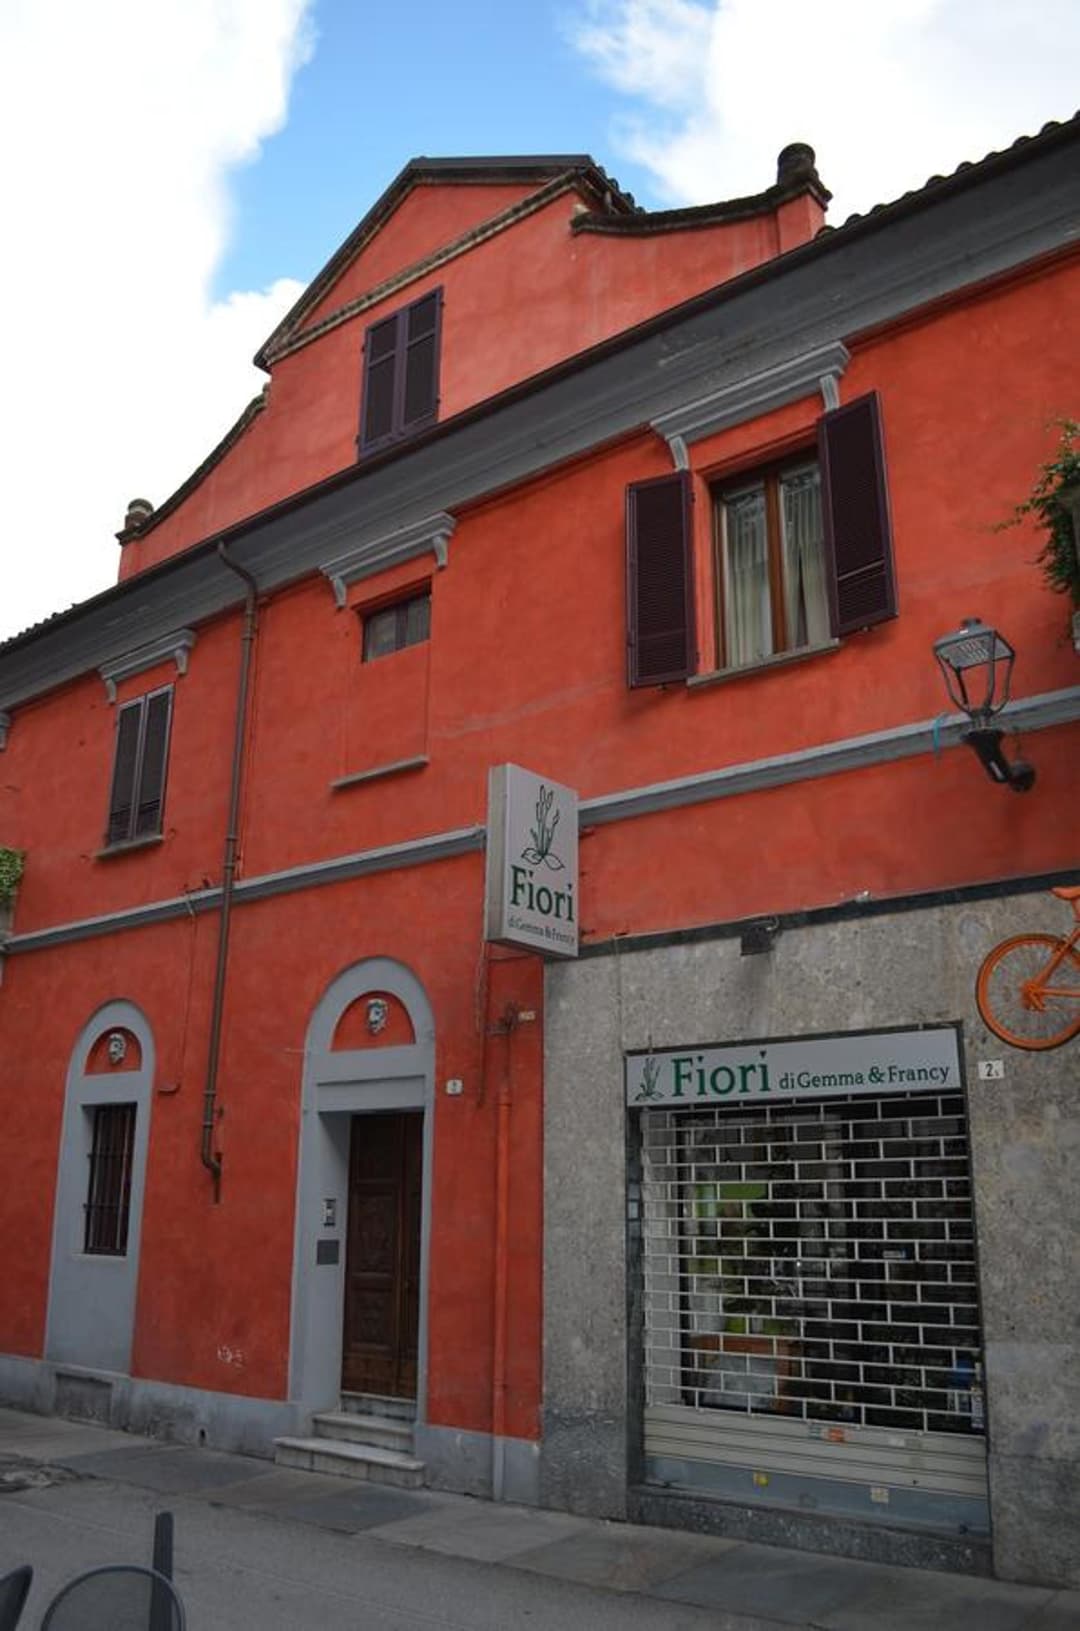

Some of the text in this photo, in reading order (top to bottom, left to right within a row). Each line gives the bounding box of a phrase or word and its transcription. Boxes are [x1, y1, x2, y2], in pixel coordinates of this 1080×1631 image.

[510, 865, 574, 922] Fiori
[672, 1051, 950, 1096] Fiori di Gemma & Francy
